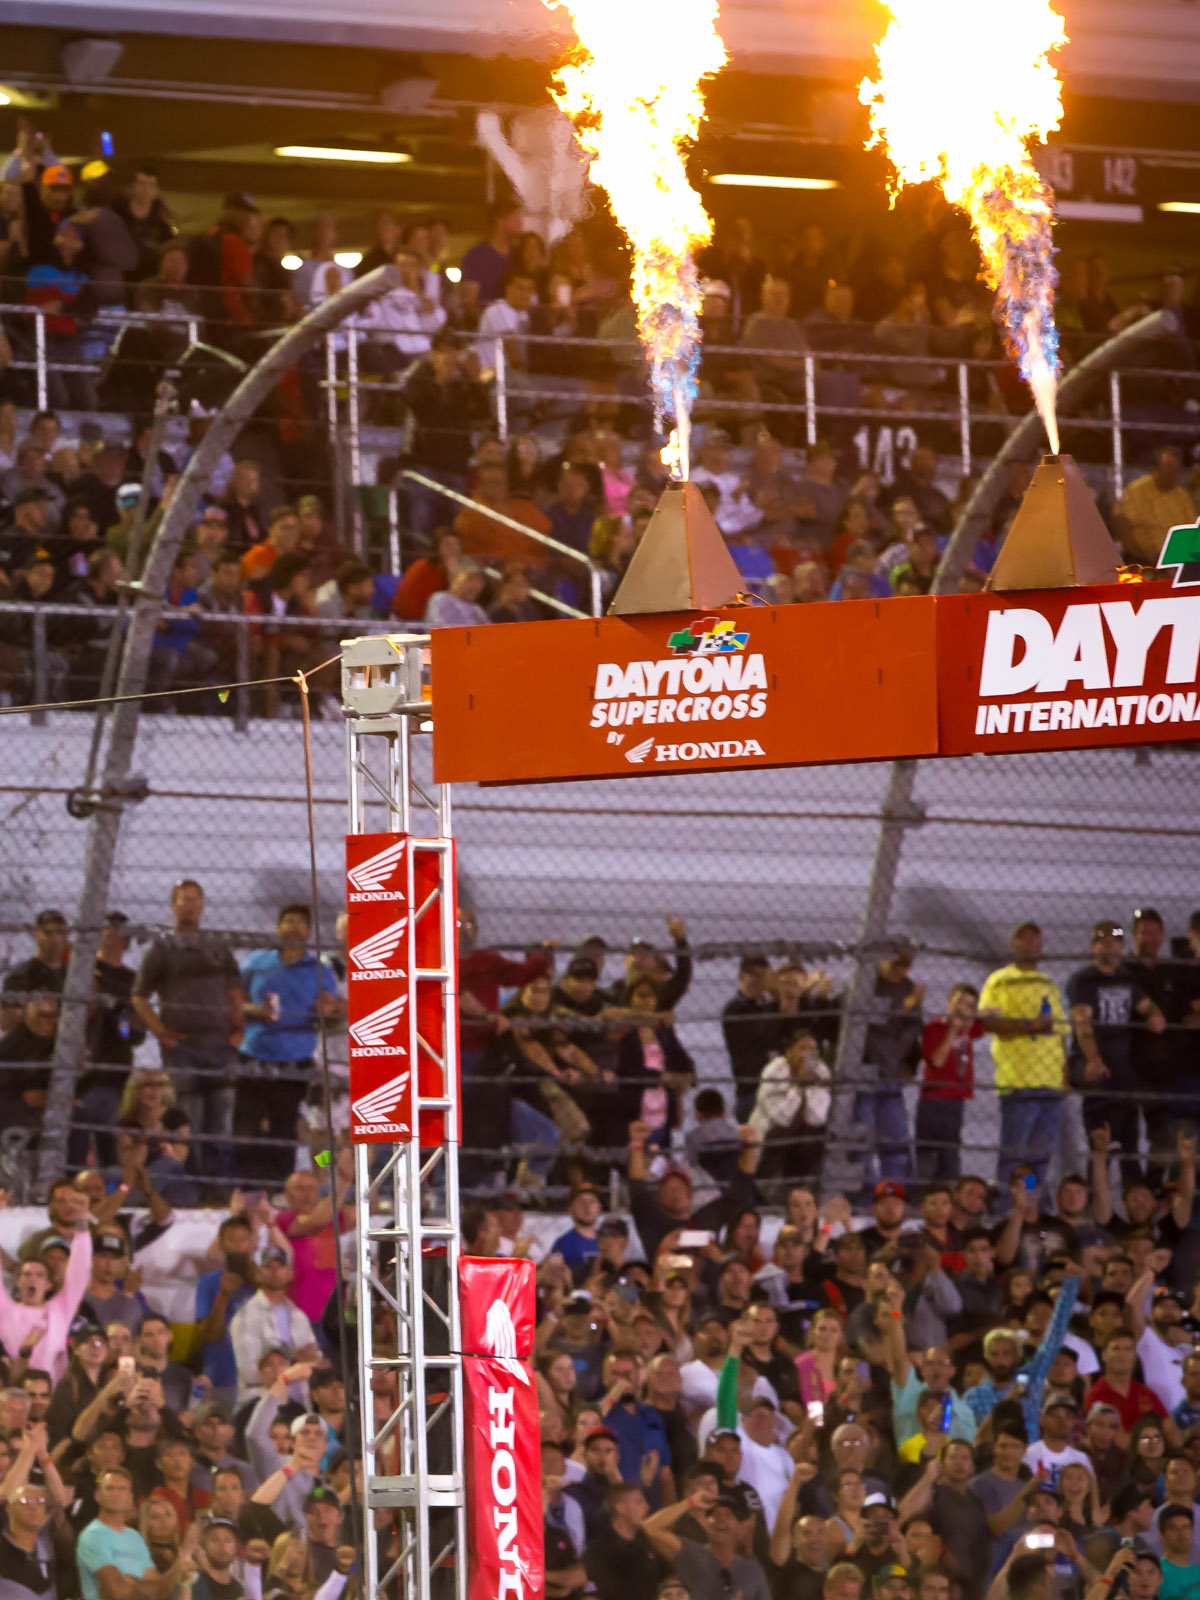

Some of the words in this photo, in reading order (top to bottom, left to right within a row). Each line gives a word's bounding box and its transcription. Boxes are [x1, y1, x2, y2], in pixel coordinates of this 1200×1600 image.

[594, 654, 768, 700] DAYTONA
[589, 692, 768, 728] SUPERCROSS
[975, 692, 1200, 735] INTERNATION
[606, 731, 625, 746] By
[655, 739, 766, 762] HONDA
[349, 891, 406, 902] HONDA
[351, 969, 408, 981] HONDA
[351, 1046, 408, 1057] HONDA
[354, 1123, 410, 1135] HONDA
